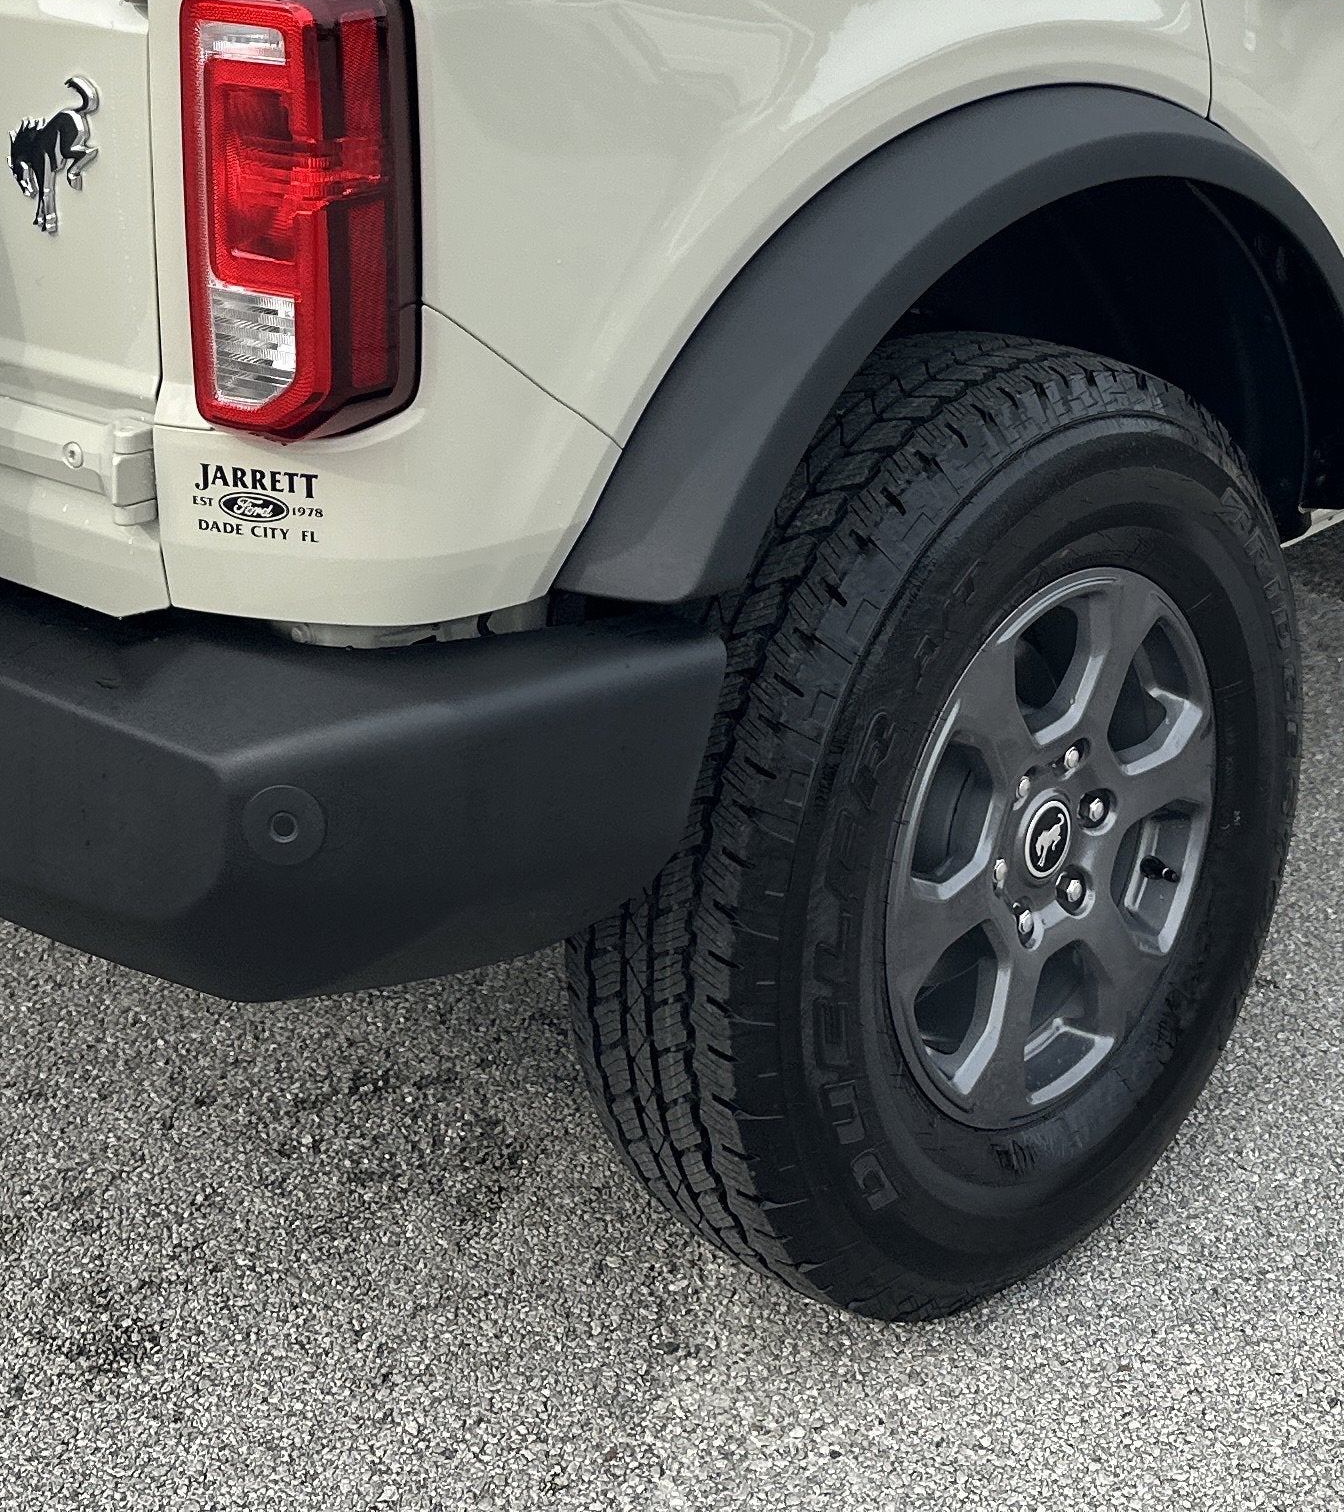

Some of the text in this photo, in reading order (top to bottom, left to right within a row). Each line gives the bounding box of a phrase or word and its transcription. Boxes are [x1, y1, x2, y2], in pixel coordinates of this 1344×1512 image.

[194, 462, 319, 499] JARRETT
[192, 495, 324, 518] EST Ford 1978
[198, 518, 319, 543] DADE CITY FL
